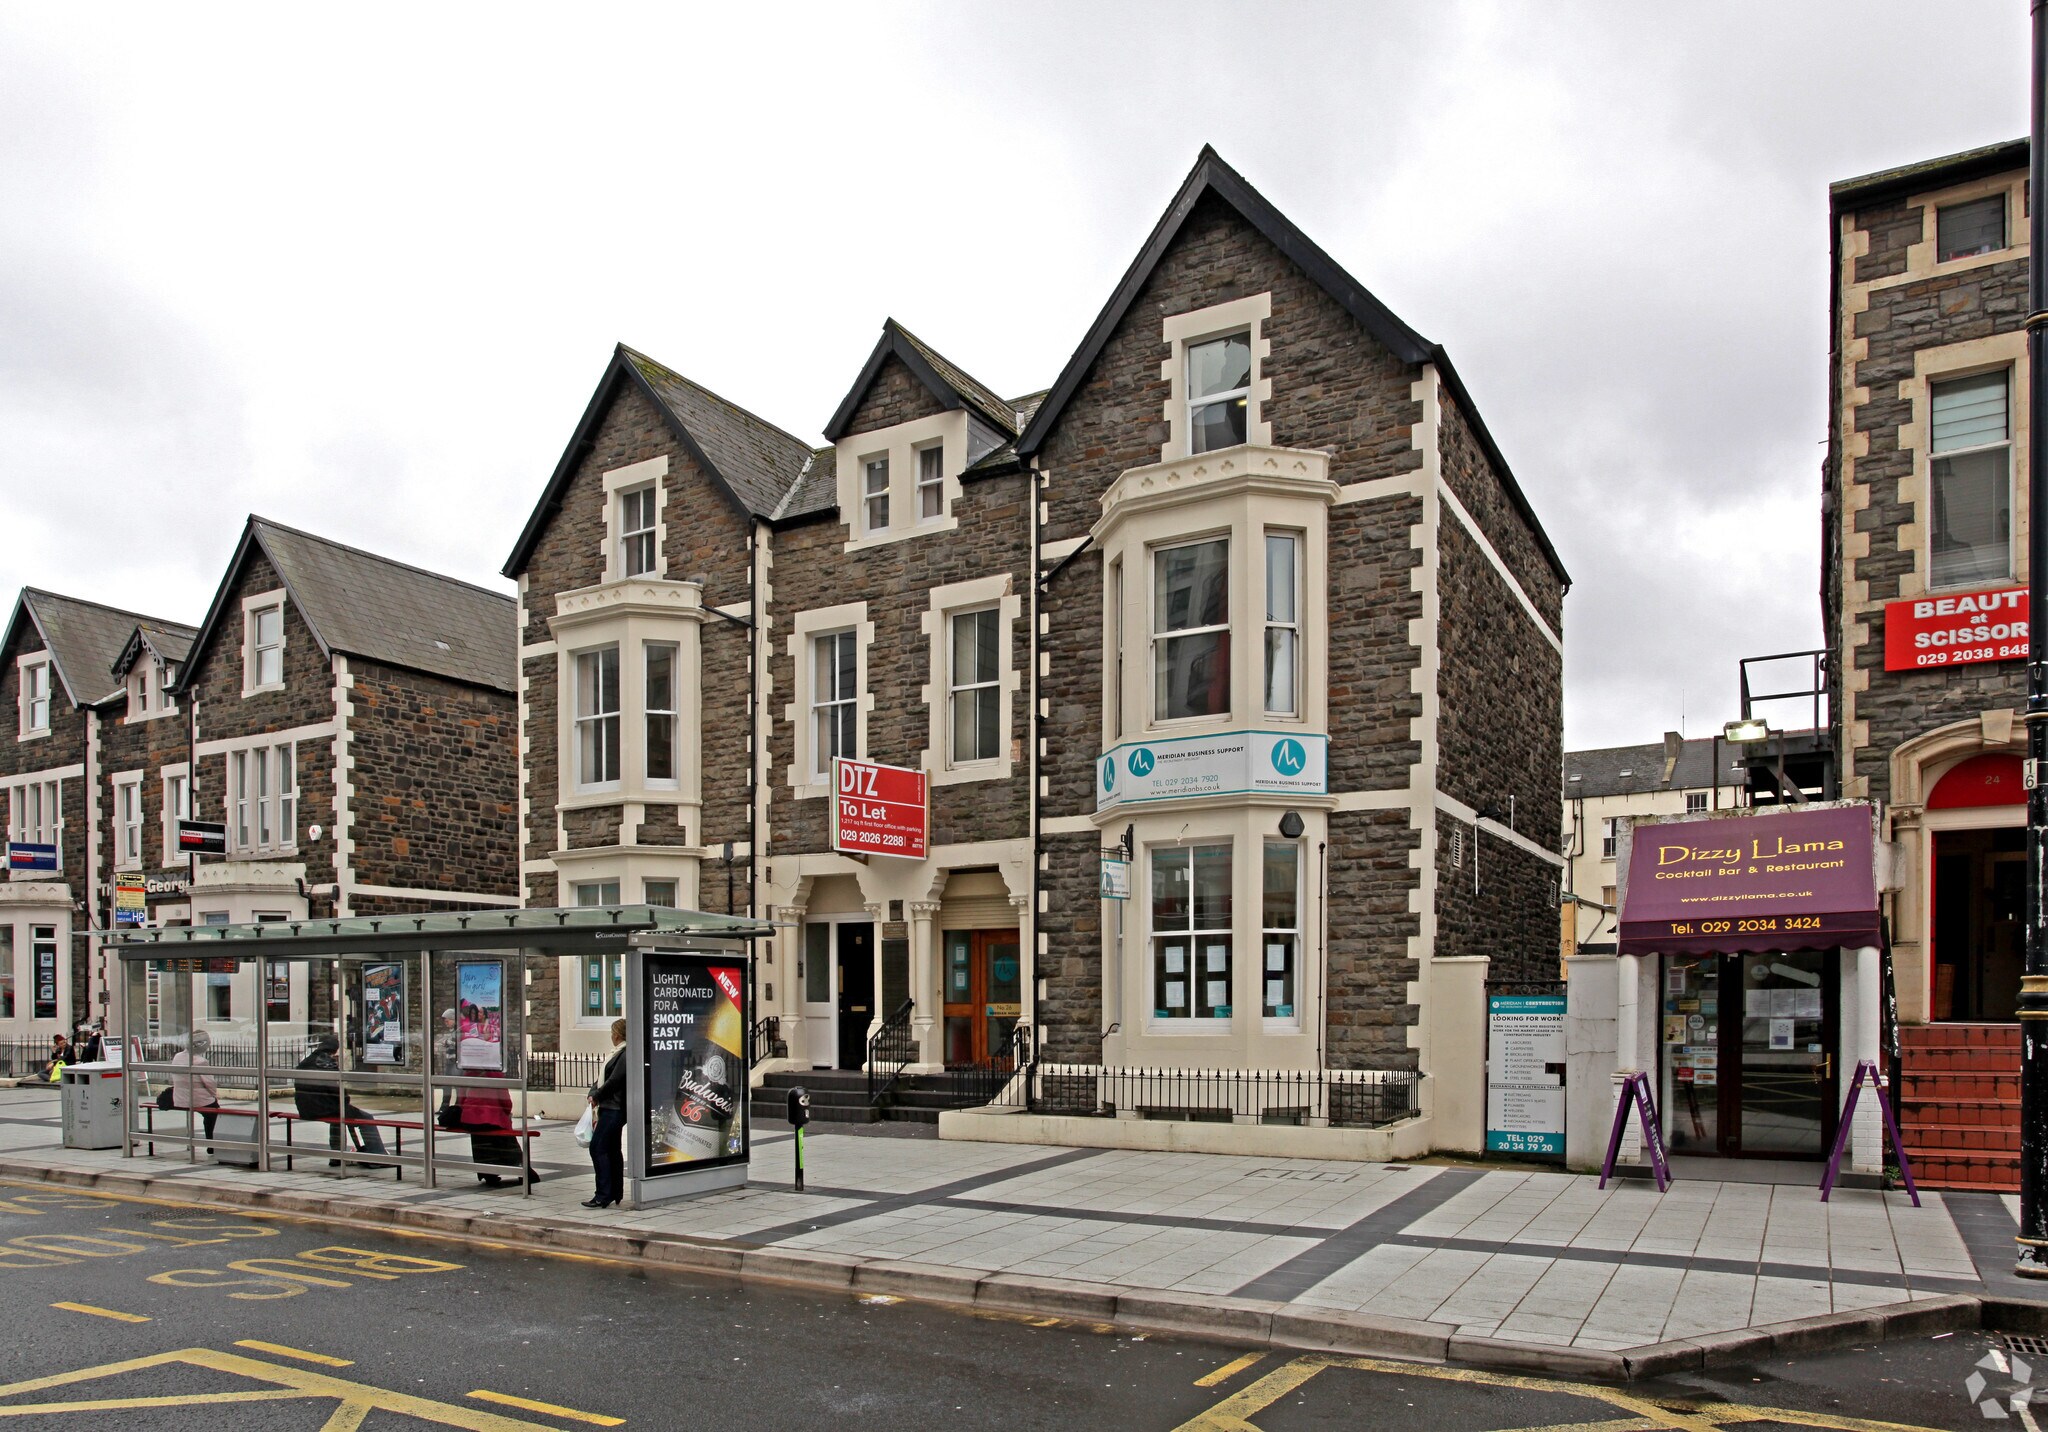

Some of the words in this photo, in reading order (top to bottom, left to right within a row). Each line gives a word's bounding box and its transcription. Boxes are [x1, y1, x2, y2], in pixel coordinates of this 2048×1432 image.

[1914, 590, 2030, 618] BEAUT
[1970, 613, 1988, 624] at
[1917, 653, 1948, 666] 029
[1952, 648, 1994, 662] 2038
[1999, 643, 2029, 657] 848
[841, 763, 879, 797] DTZ
[1181, 777, 1198, 785] 2034
[1985, 776, 2000, 784] 24
[1150, 784, 1220, 795] www.meridianbs.co.uk
[840, 800, 858, 816] To
[862, 804, 887, 820] Let
[841, 830, 857, 841] 029
[859, 832, 881, 844] 2026
[883, 834, 904, 846] 2288
[1657, 844, 1740, 865] Dizzy
[1752, 837, 1845, 860] Llama
[1655, 868, 1711, 880] Cocktail
[1718, 867, 1740, 877] Bar
[1748, 865, 1758, 874] &
[1766, 859, 1844, 872] Restaurant
[1680, 890, 1812, 903] www.dizzyllama.co.uk
[132, 912, 145, 922] HP
[1671, 922, 1694, 935] Tel:
[1701, 921, 1730, 934] 029
[1738, 919, 1776, 932] 2034
[1785, 917, 1820, 930] 3424
[653, 974, 690, 985] LIGHTLY
[717, 971, 740, 998] NEW
[653, 987, 713, 998] CARBONATED
[654, 1000, 669, 1011] FOR
[670, 1000, 679, 1011] A
[653, 1014, 694, 1024] SMOOTH
[653, 1027, 680, 1037] EASY
[653, 1040, 685, 1051] TASTE
[146, 1245, 466, 1300] BUS
